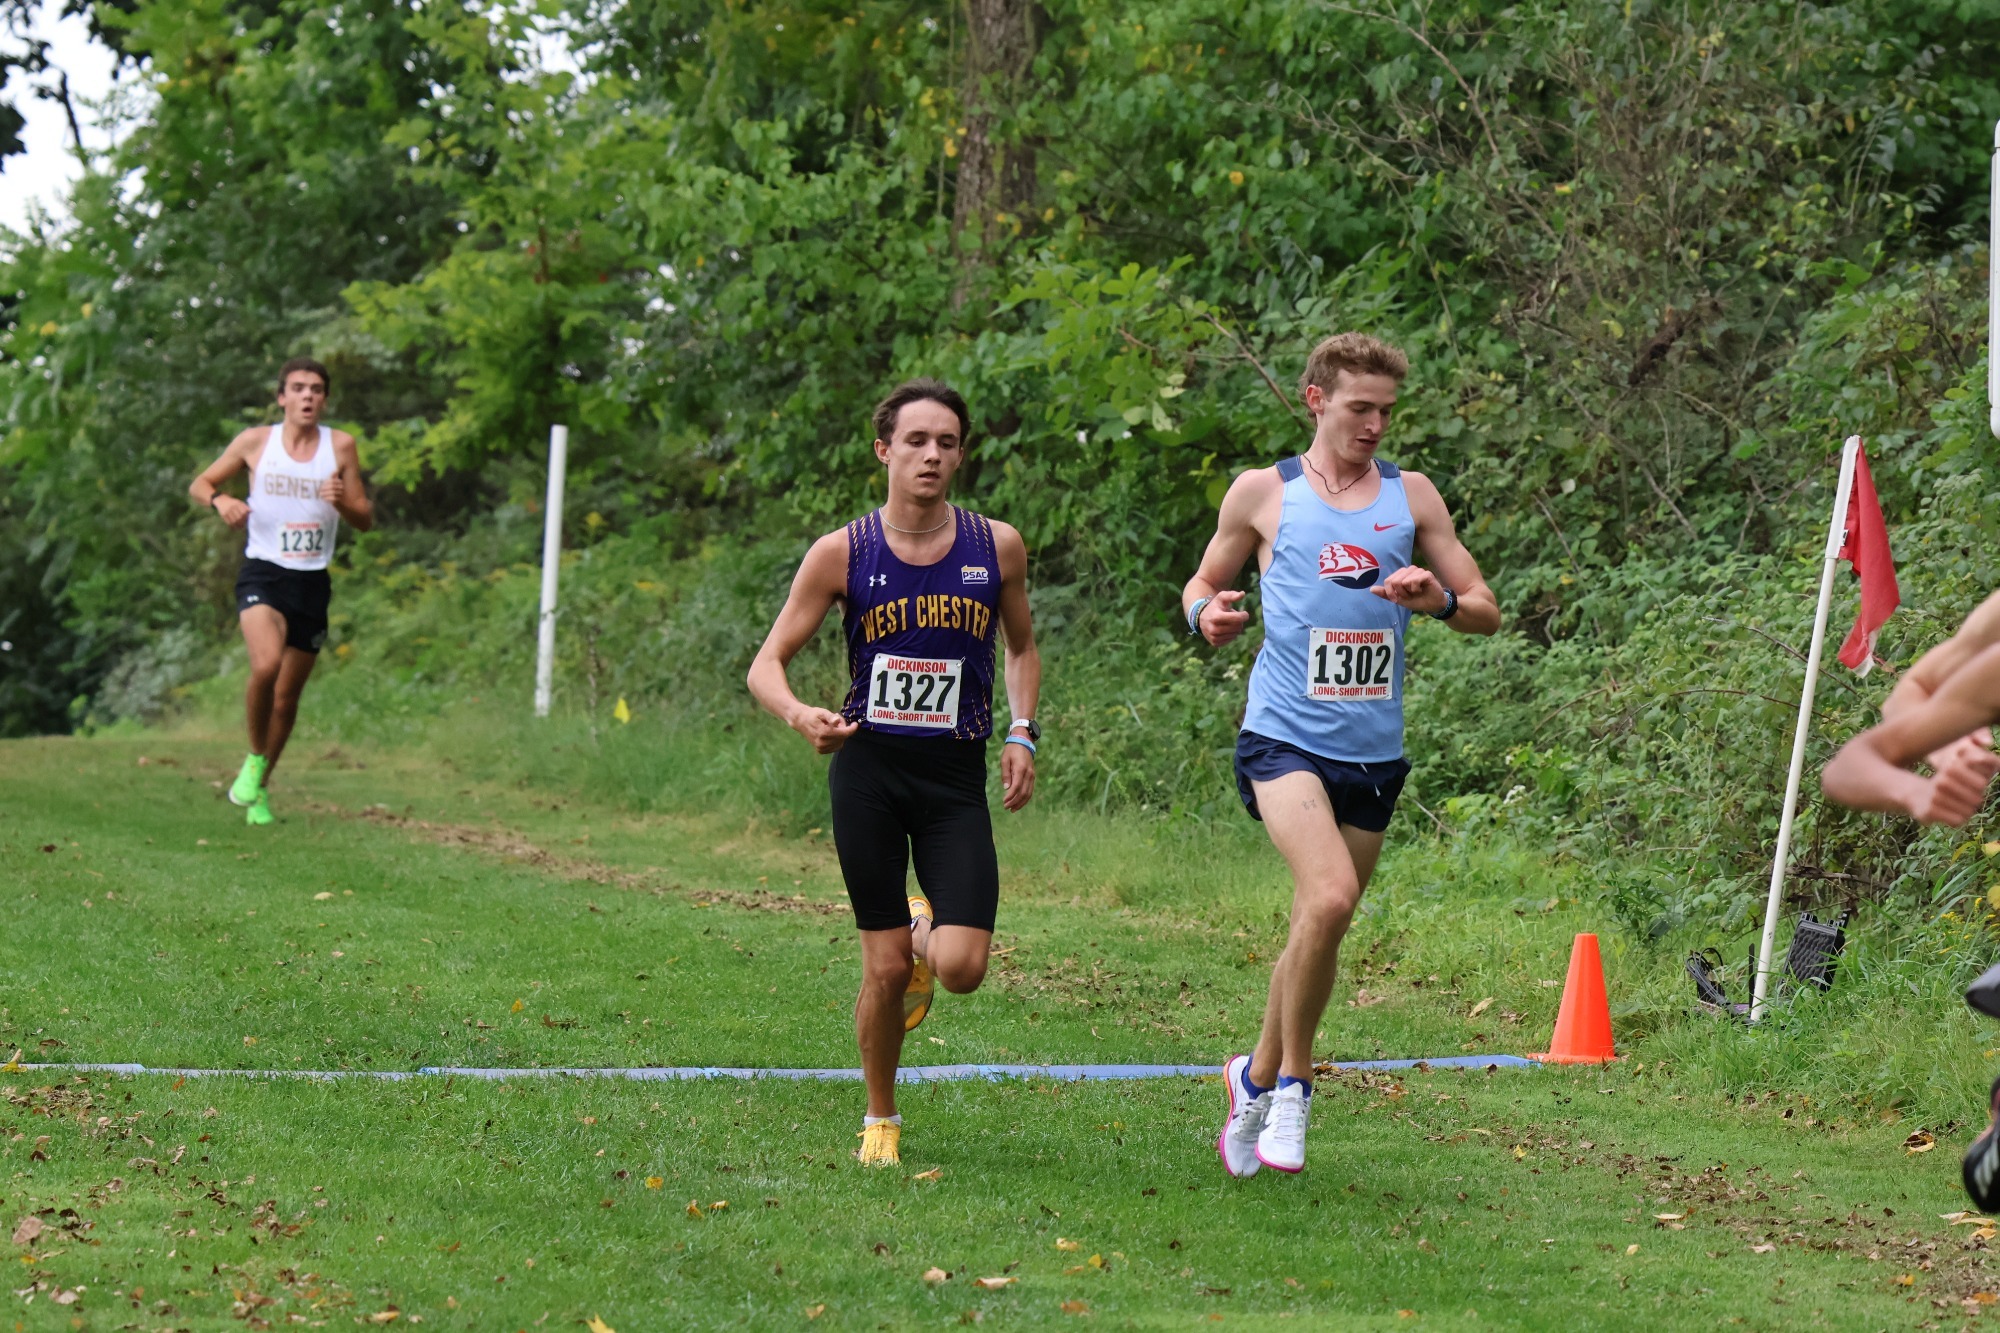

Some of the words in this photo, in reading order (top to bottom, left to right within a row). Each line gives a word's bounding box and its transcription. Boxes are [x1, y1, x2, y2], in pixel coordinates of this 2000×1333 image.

[264, 473, 323, 500] GENEV
[281, 529, 324, 552] 1232
[963, 571, 988, 579] PSAC
[861, 597, 908, 643] WEST
[916, 594, 990, 641] CHESTER
[1326, 631, 1384, 644] DICKINSON
[887, 658, 947, 673] DICKINSON
[1314, 645, 1391, 685] 1302
[874, 670, 956, 712] 1327
[1314, 686, 1363, 696] LONG-SHORT
[1365, 686, 1387, 695] INVITE
[873, 709, 924, 722] LONG-SHORT
[925, 714, 951, 724] INVITE
